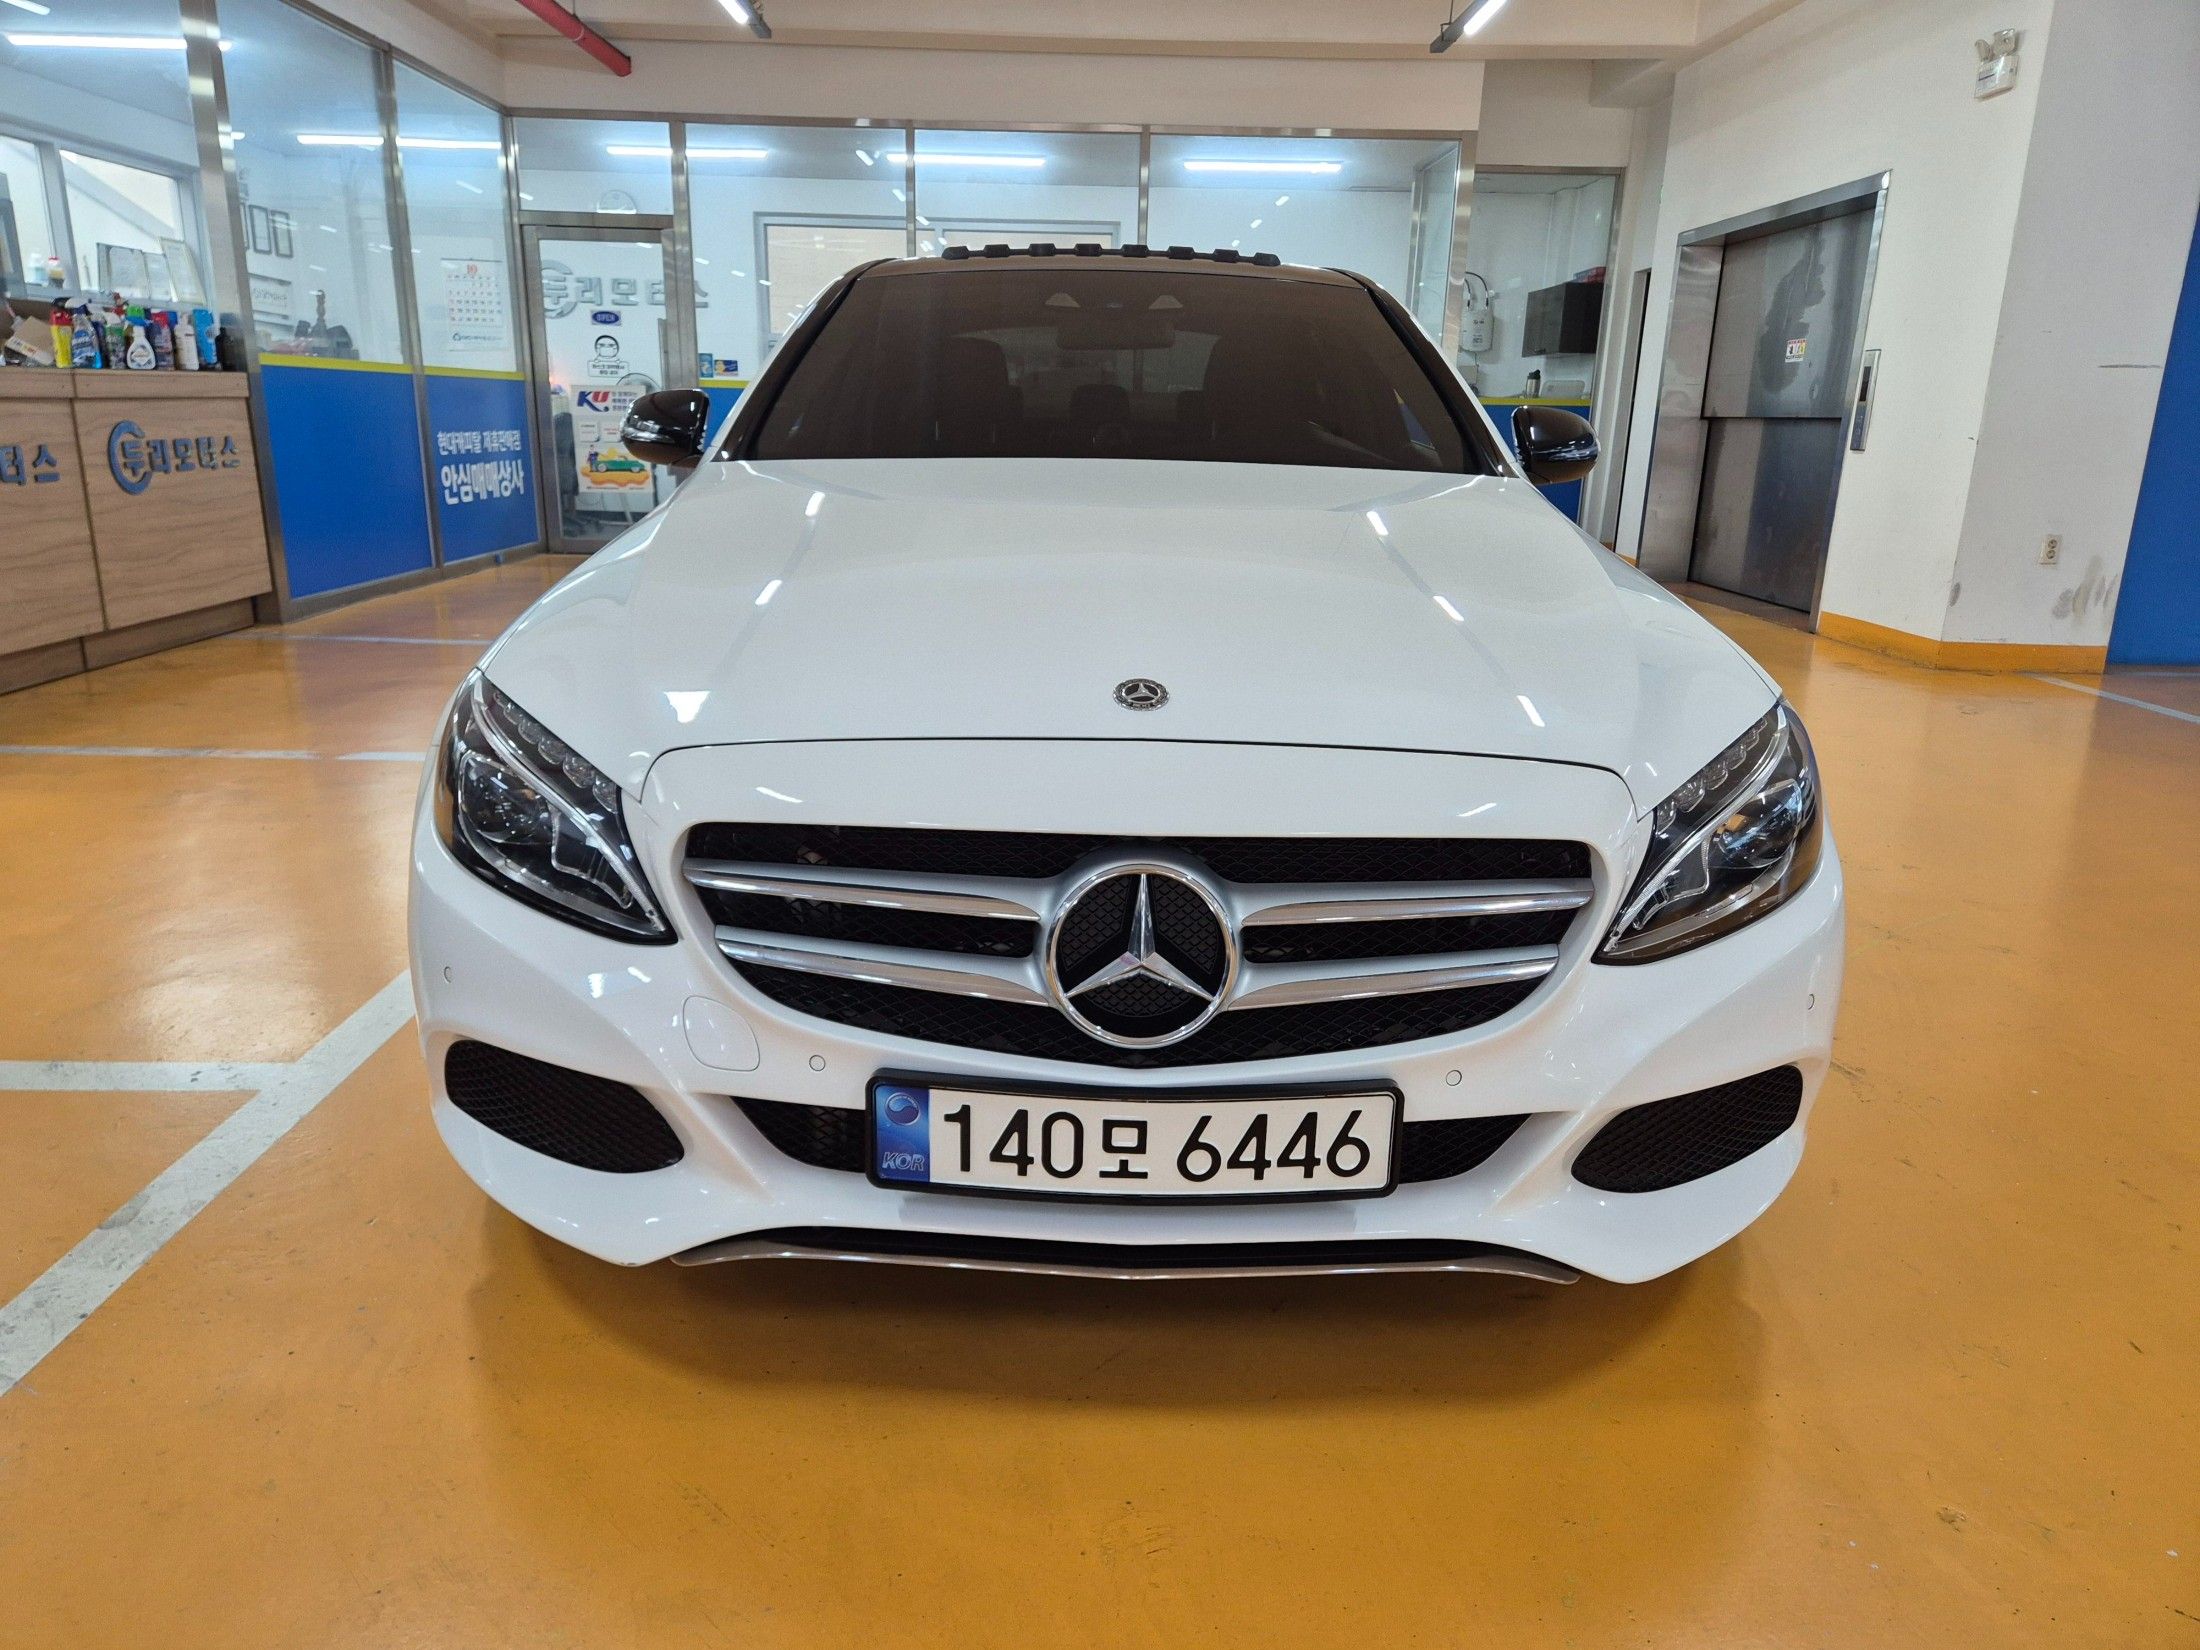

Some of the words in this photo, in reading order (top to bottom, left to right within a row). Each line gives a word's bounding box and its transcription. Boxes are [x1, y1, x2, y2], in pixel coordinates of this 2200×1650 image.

[119, 434, 242, 478] 두리모터스
[440, 459, 525, 505] 안심매매상사
[881, 1151, 925, 1172] KOR
[1175, 1108, 1371, 1183] 6446
